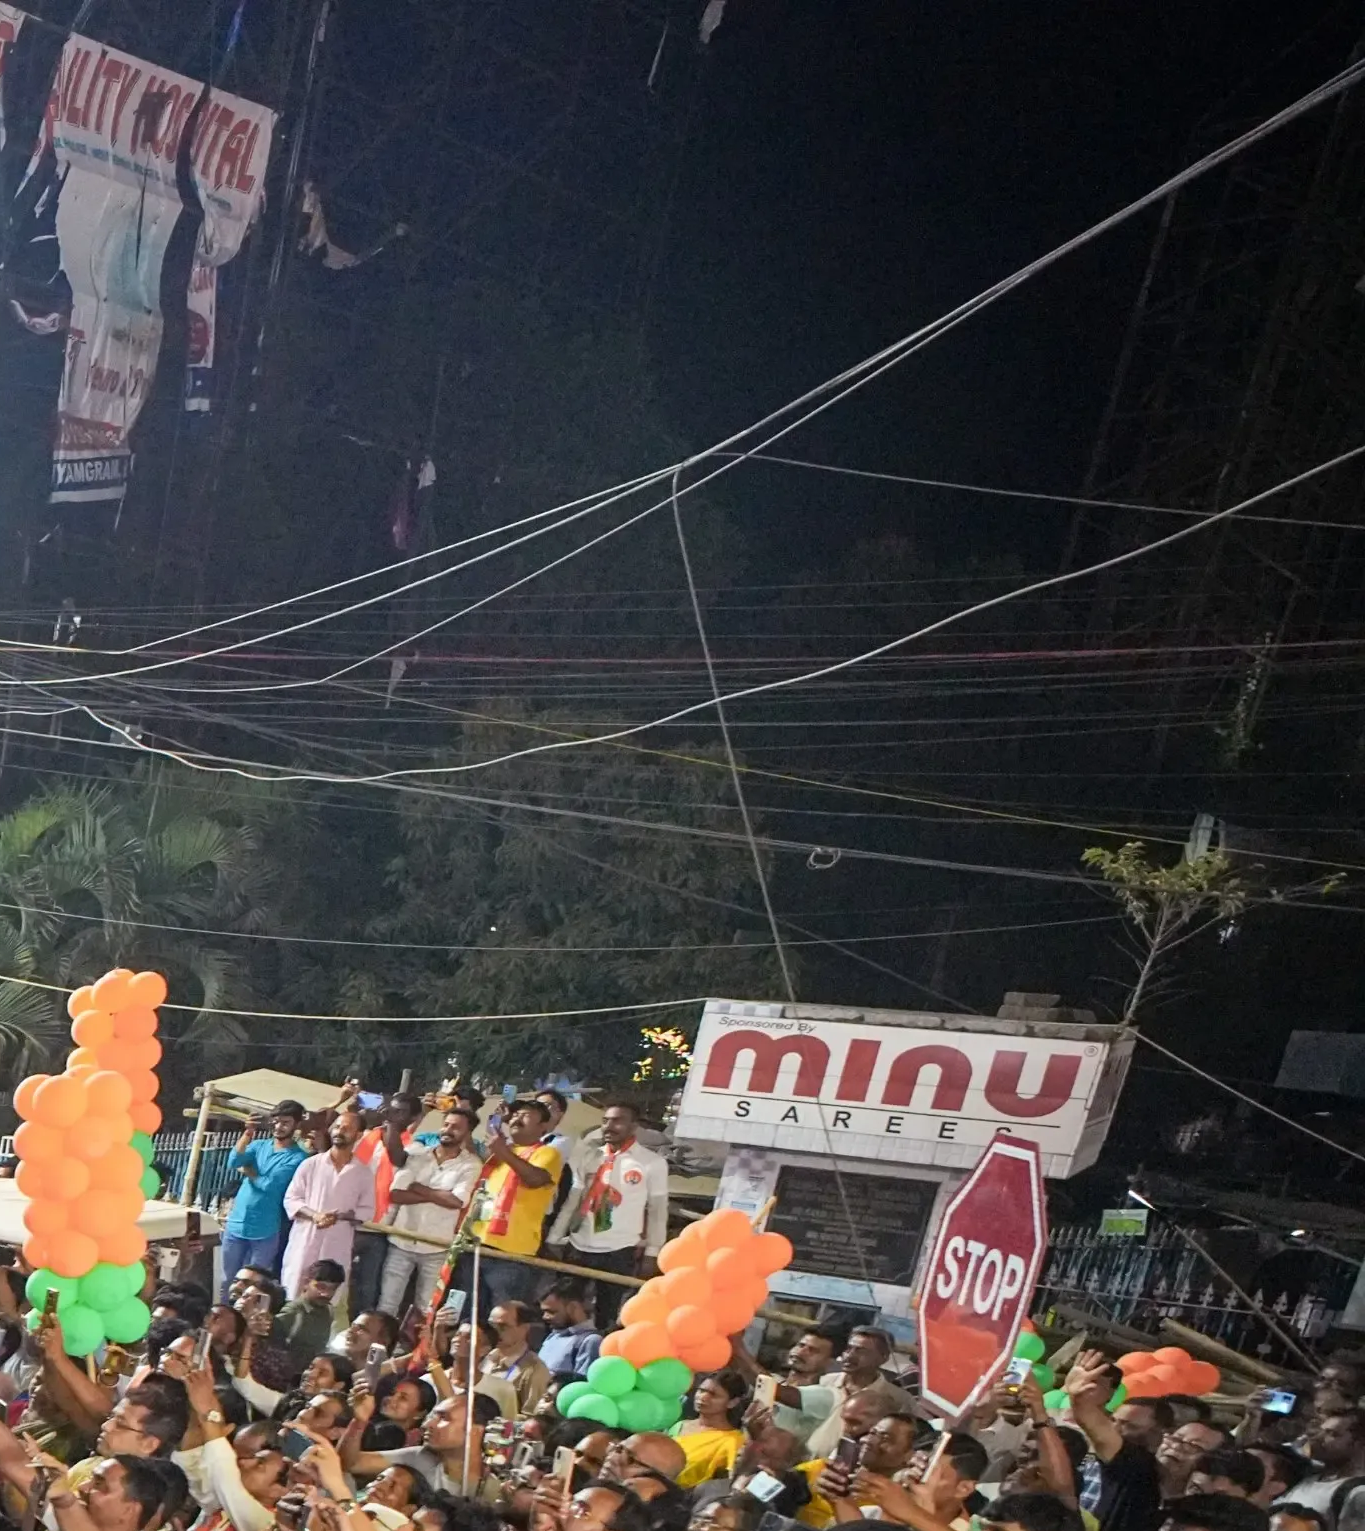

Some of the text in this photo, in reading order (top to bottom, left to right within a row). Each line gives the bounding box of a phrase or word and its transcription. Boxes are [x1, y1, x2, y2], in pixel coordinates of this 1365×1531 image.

[718, 1015, 818, 1036] Sponsored By
[936, 1236, 1026, 1321] STOP
